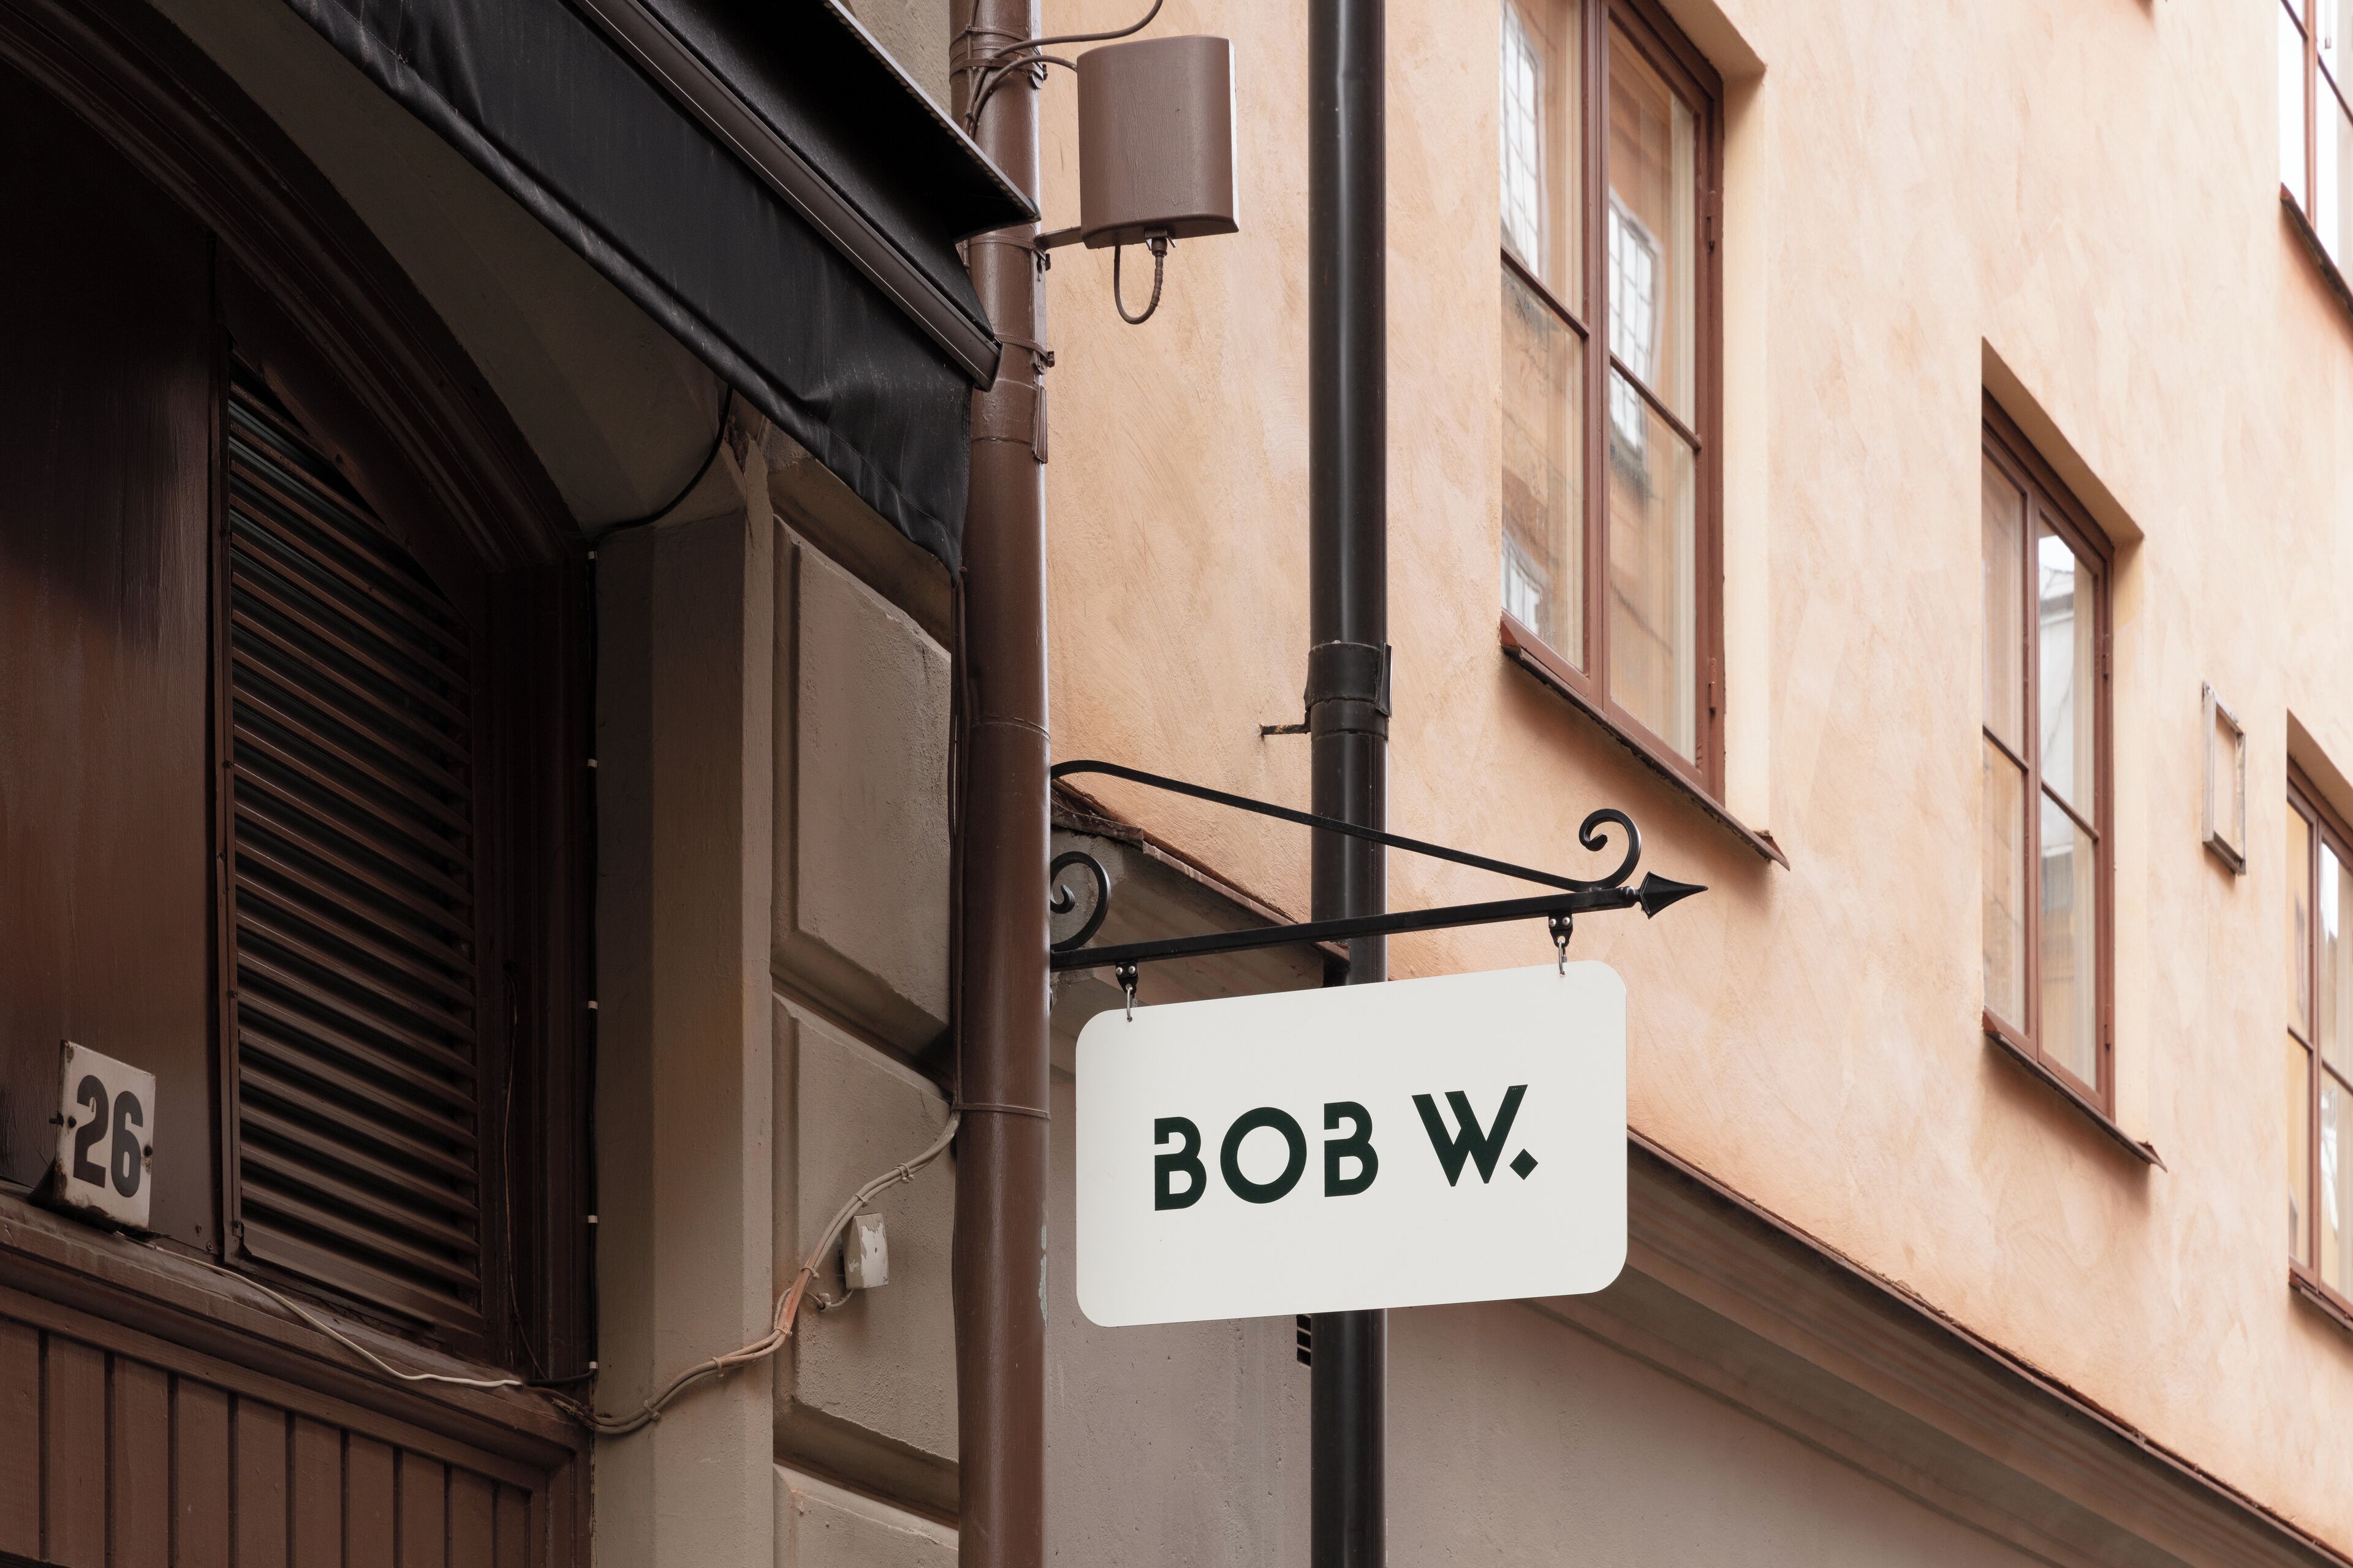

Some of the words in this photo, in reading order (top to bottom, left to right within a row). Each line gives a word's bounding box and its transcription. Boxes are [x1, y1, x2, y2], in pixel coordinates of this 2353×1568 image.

[73, 1075, 143, 1198] 26
[1154, 1102, 1378, 1211] BOB
[1412, 1085, 1538, 1187] W.
